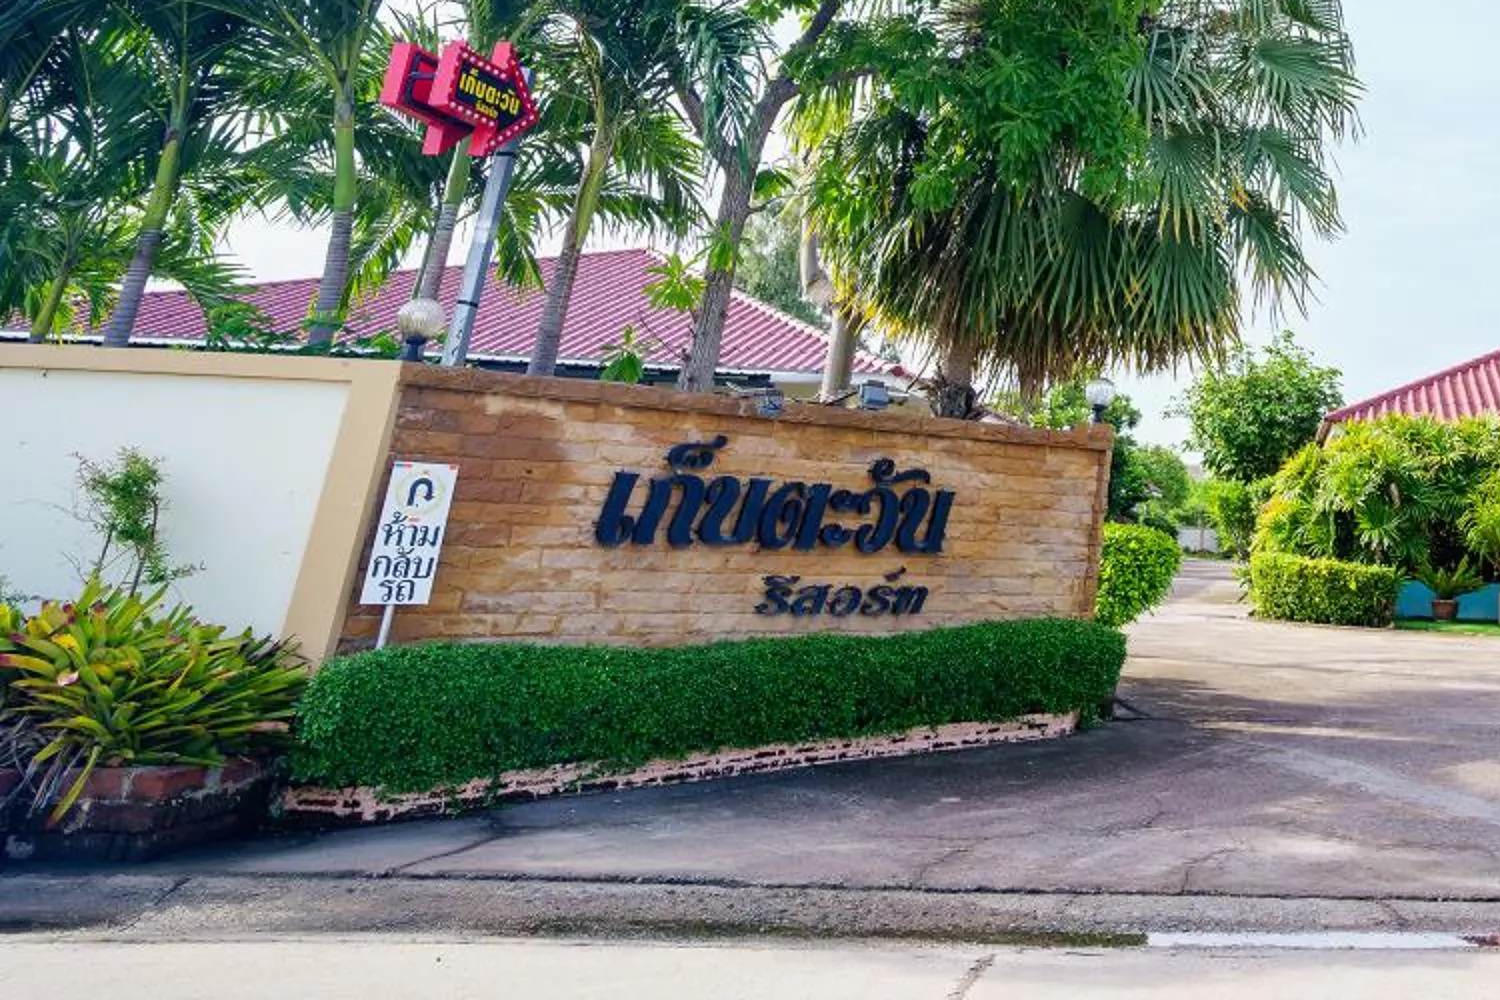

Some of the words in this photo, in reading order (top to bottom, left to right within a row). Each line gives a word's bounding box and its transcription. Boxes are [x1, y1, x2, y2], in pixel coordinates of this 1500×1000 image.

[460, 68, 520, 115] เก็บตะวัน
[594, 435, 956, 554] เก็บตะวัน
[382, 511, 441, 547] ห้าม
[371, 548, 435, 579] กลับ
[379, 579, 416, 603] รถ
[754, 566, 929, 617] รีสอร์ท
